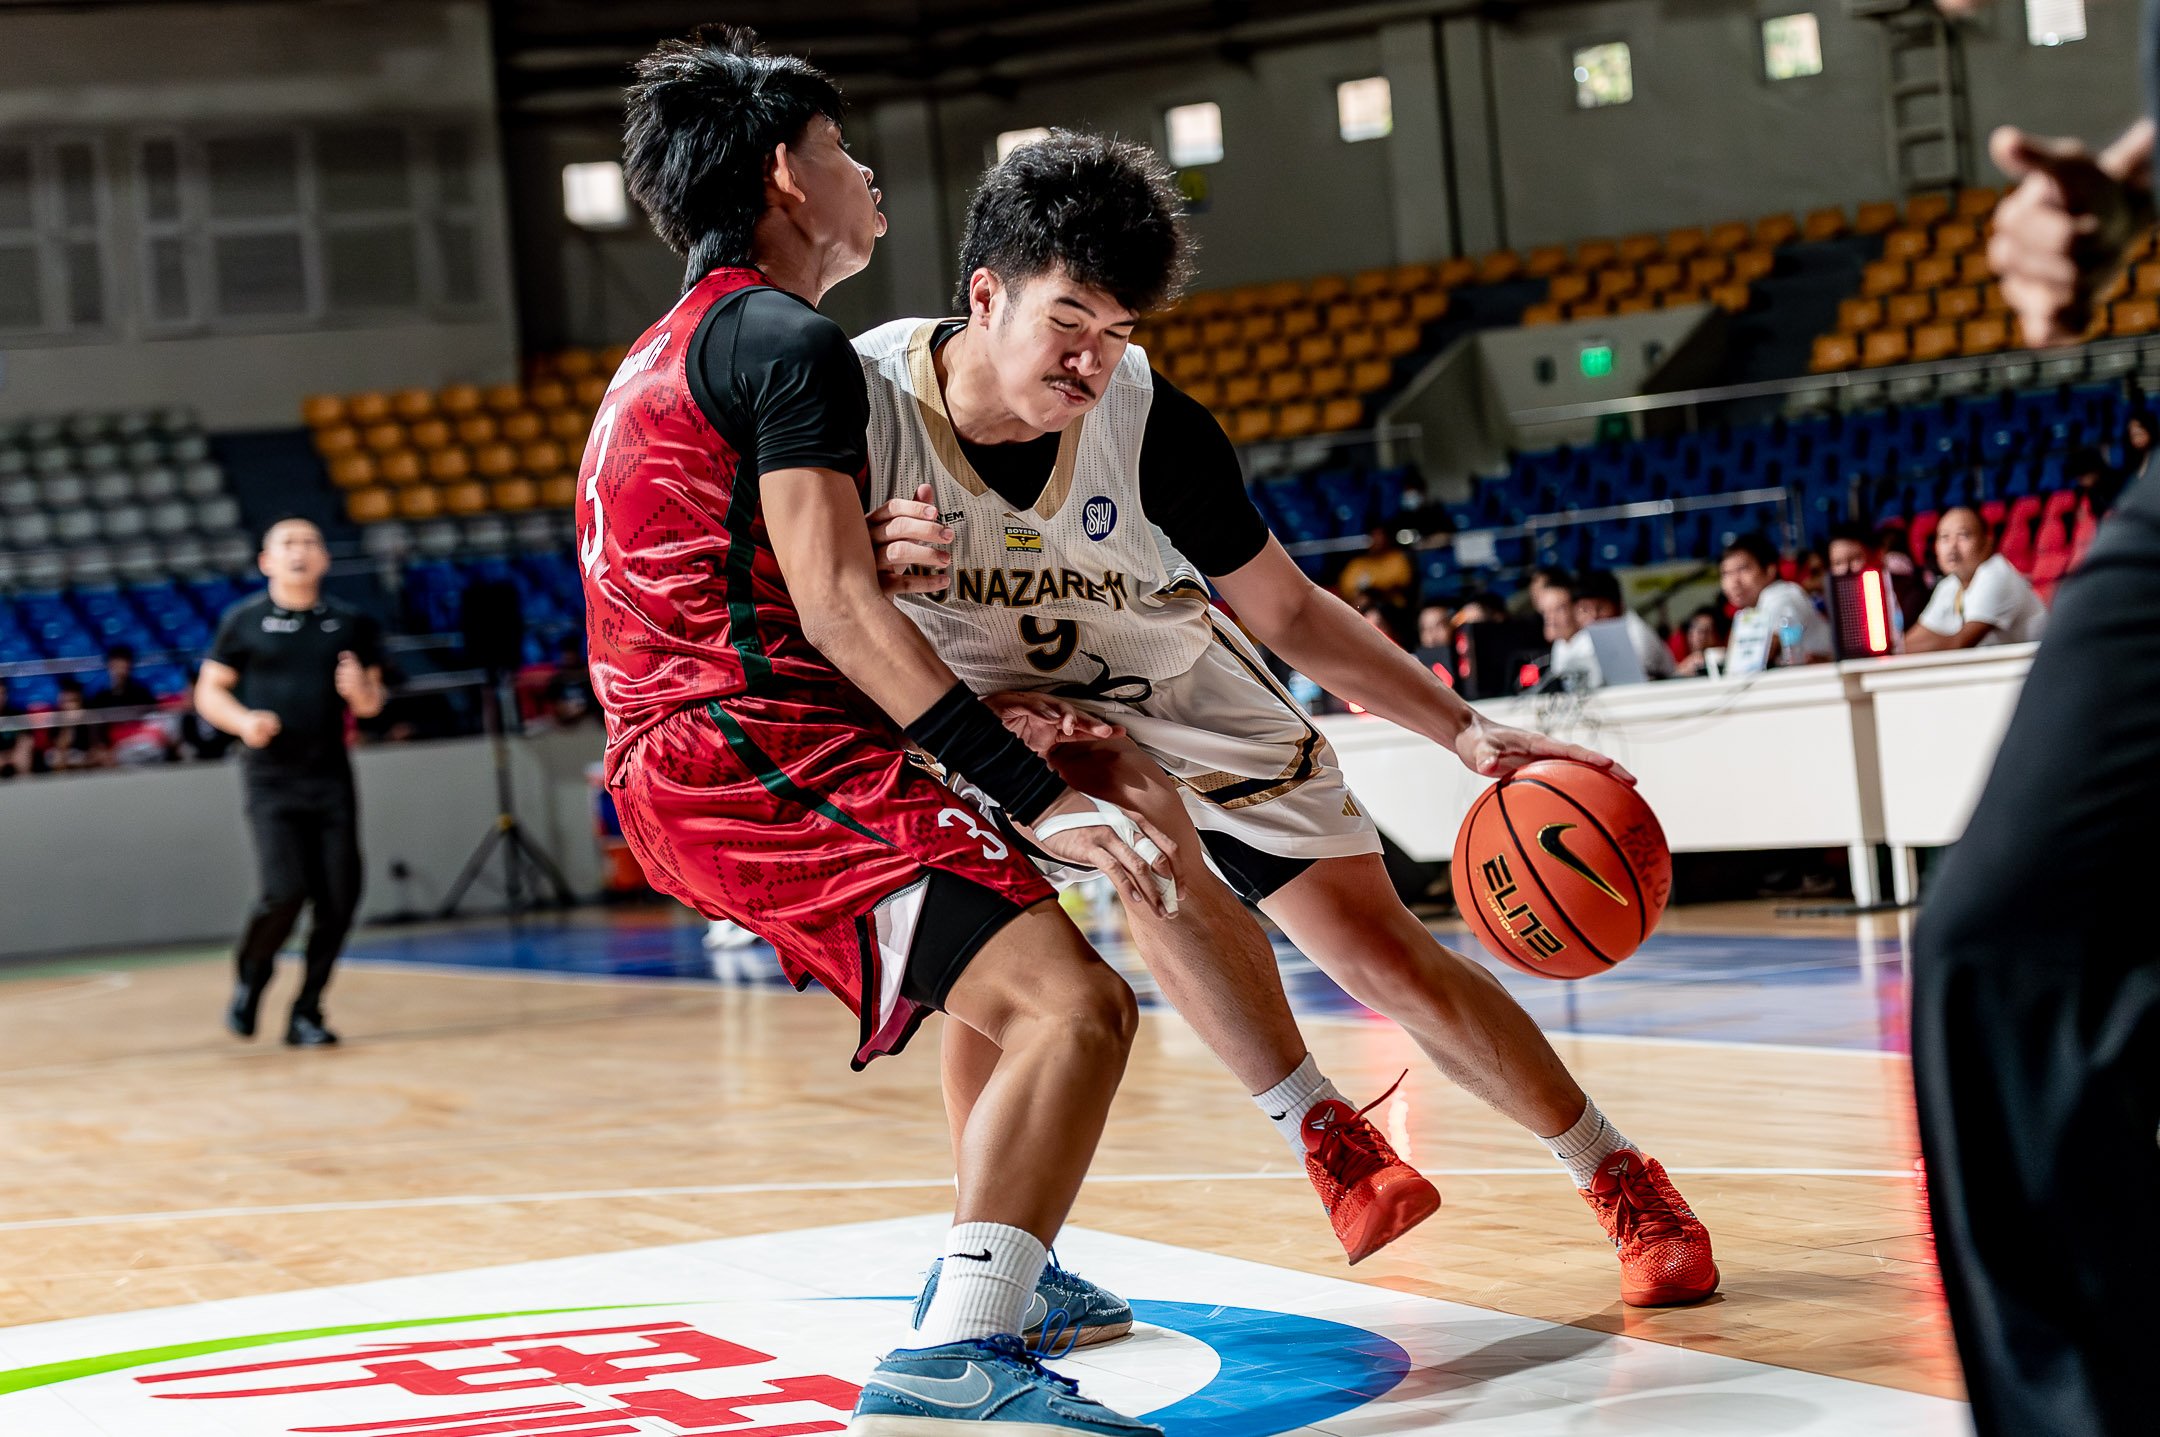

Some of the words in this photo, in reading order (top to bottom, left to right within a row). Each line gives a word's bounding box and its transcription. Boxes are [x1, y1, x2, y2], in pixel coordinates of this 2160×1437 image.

[581, 403, 617, 578] 3
[937, 510, 965, 523] TEM
[1006, 527, 1039, 536] BOYSEN
[1086, 502, 1112, 536] SM
[1018, 613, 1080, 673] 9
[937, 807, 1009, 860] 3
[1482, 852, 1568, 959] ELITE
